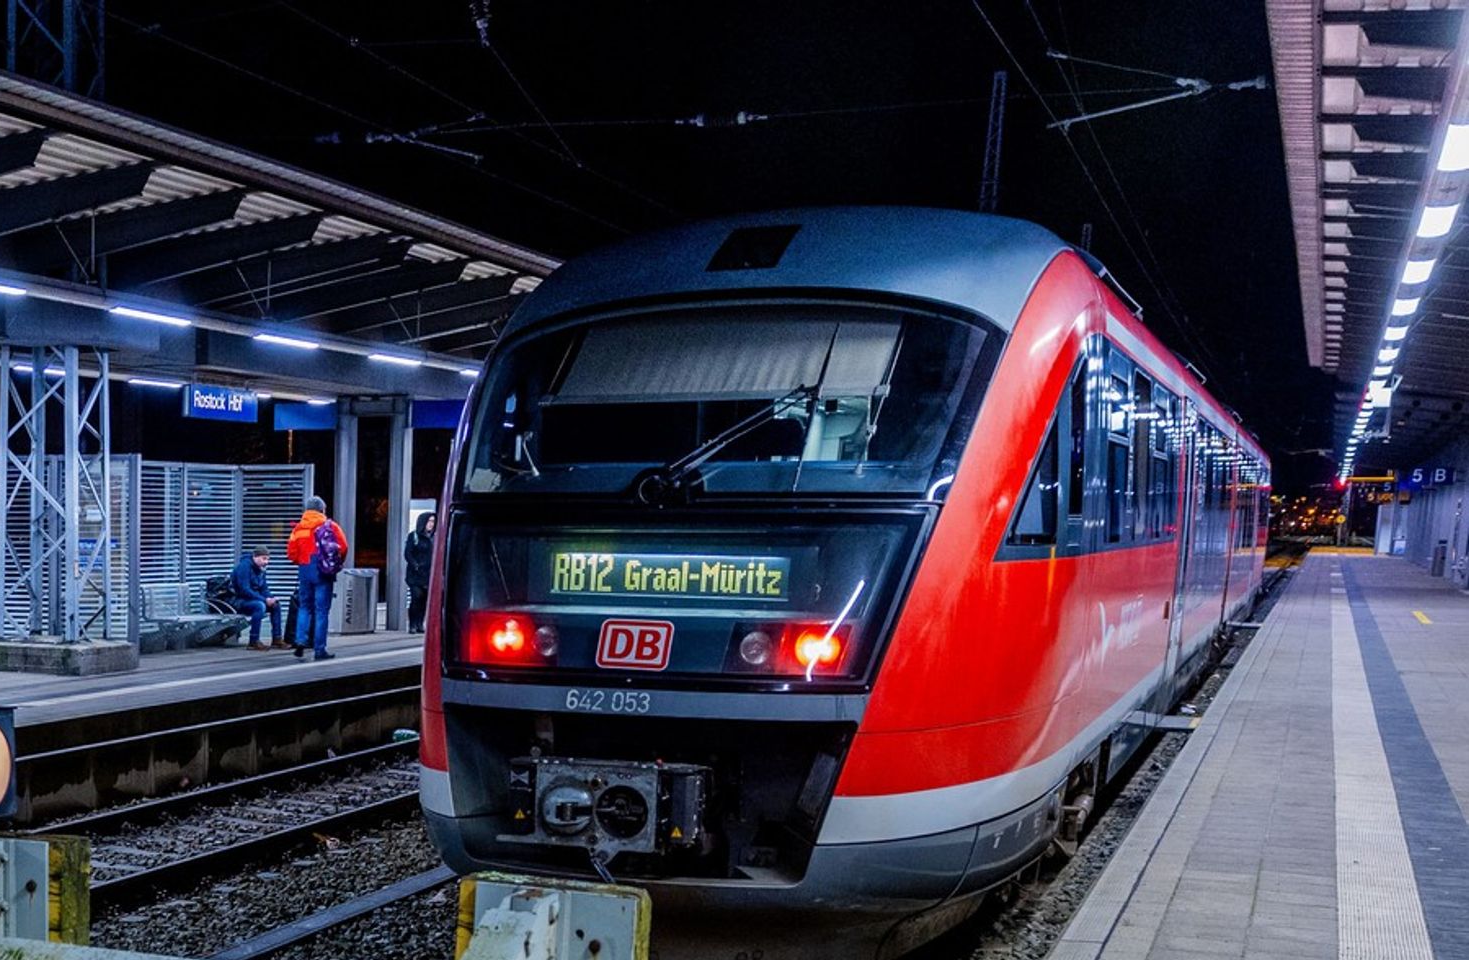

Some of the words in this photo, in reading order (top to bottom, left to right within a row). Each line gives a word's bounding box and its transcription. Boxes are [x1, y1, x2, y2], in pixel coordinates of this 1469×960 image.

[193, 390, 226, 411] Rostock
[227, 394, 244, 412] Hbf
[1411, 468, 1424, 483] 5
[1434, 468, 1447, 483] B
[553, 553, 615, 593] RB12
[623, 559, 783, 596] Graal-Müritz
[606, 627, 663, 662] DB
[565, 688, 606, 712] 642
[610, 691, 652, 714] 053
